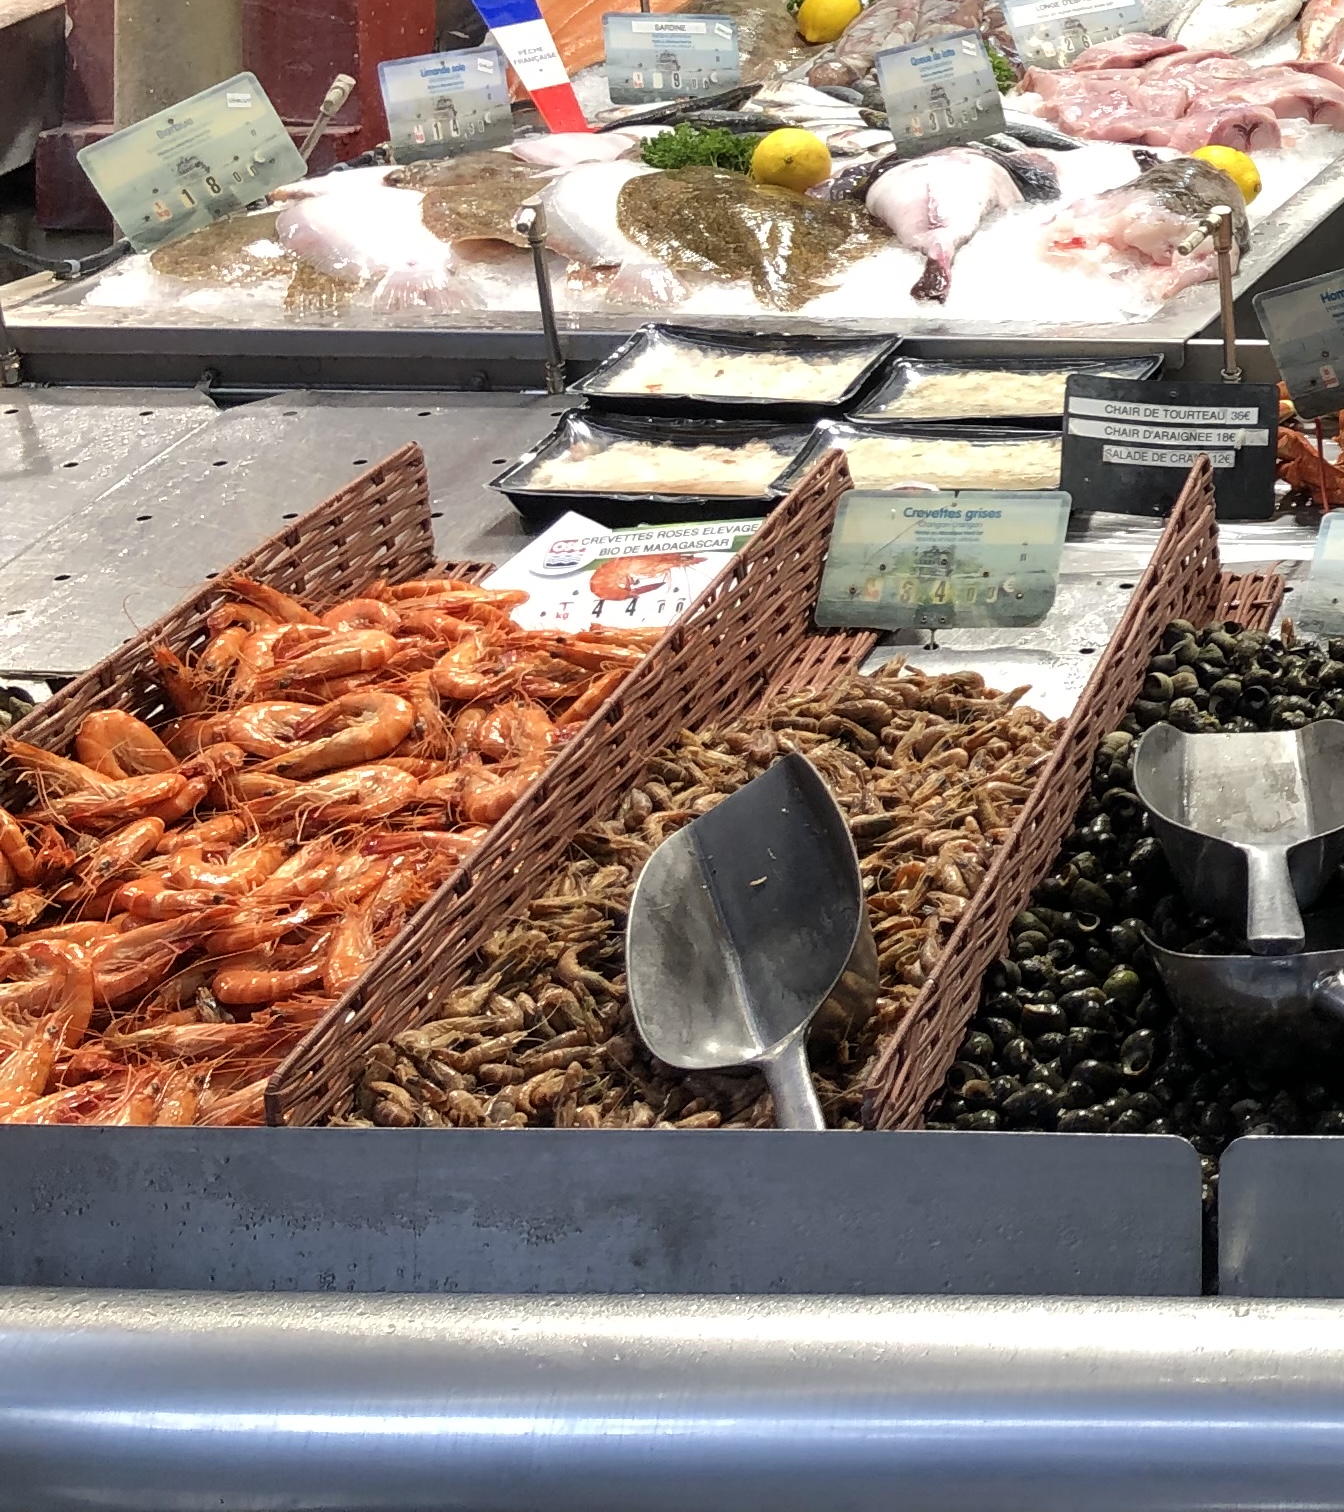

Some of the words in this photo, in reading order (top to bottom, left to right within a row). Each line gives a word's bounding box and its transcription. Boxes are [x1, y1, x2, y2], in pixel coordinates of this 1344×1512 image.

[1036, 1, 1060, 11] LONGE
[513, 52, 556, 65] FRANÇAISE
[421, 64, 450, 77] Limande
[1104, 404, 1141, 417] CHAIR
[1144, 408, 1159, 419] DE
[1164, 409, 1225, 421] TOURTEAU
[1231, 411, 1250, 421] 36€
[1104, 426, 1140, 439] CHAIR
[1143, 429, 1213, 442] D'ARAIGNEE
[1217, 432, 1236, 442] 18€
[1104, 448, 1148, 462] SALADE
[1151, 451, 1166, 462] DE
[1212, 454, 1230, 464] 12€
[903, 508, 962, 519] Crevettes
[965, 507, 1002, 521] grises
[582, 532, 653, 547] CREVETTES
[657, 528, 699, 539] ROSES
[703, 523, 760, 535] ELEVAGE
[599, 546, 620, 556] BIO
[623, 544, 640, 555] DE
[643, 539, 730, 553] MADAGASCAR
